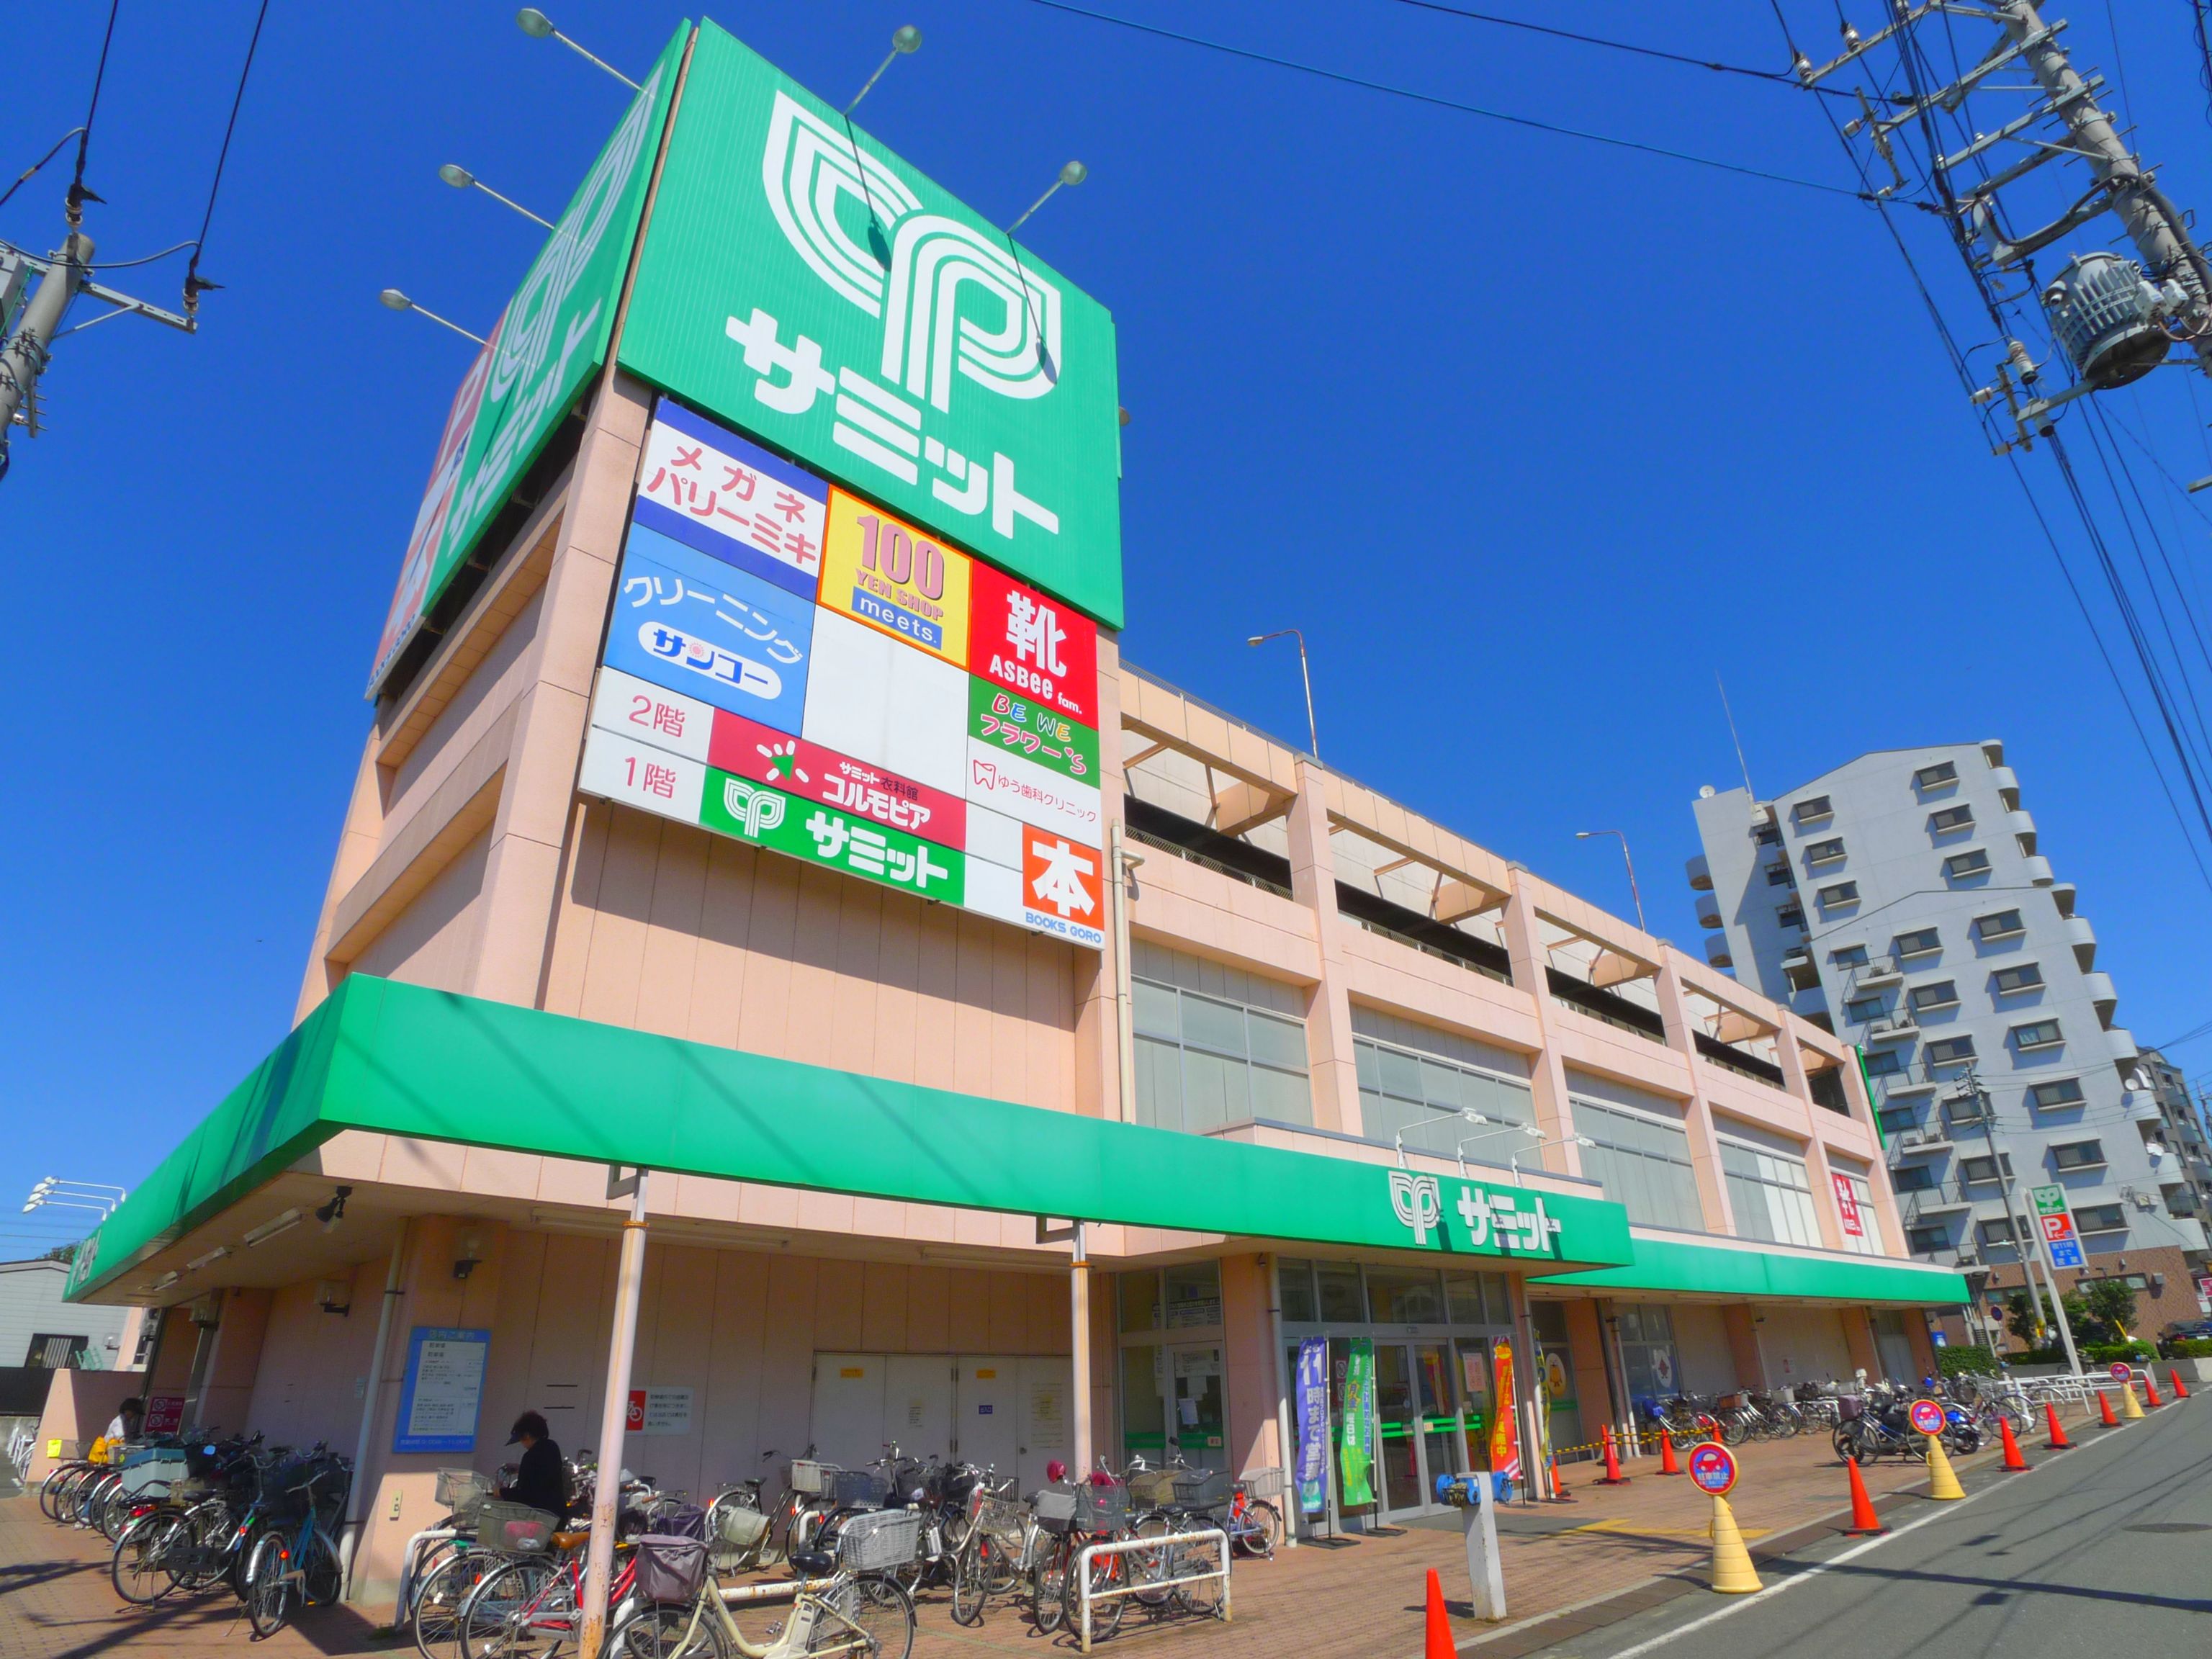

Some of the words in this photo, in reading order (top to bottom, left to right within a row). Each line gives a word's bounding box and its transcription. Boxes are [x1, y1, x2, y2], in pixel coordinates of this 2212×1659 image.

[726, 307, 1059, 540] サミット
[671, 446, 806, 523] メガネ
[647, 467, 817, 565] パリーミキ
[856, 513, 944, 601] 100
[624, 575, 804, 664] クリーニング
[855, 568, 891, 598] YEN
[894, 585, 944, 621] SHOP
[860, 596, 938, 644] meets.
[653, 629, 768, 685] サンコー
[1007, 590, 1067, 677] 靴
[989, 655, 1053, 701] ASBee
[1057, 692, 1082, 714] fam.
[629, 695, 685, 738] 2階
[992, 693, 1027, 722] BE
[1036, 712, 1072, 742] WE
[624, 756, 677, 799] 1階
[823, 773, 931, 830] コルモピア
[998, 775, 1097, 822] ゆう歯科クリニック
[806, 810, 948, 889] サミット
[1032, 839, 1095, 917] 本
[1026, 912, 1066, 934] BOOKS
[1069, 925, 1102, 944] GORO
[1457, 1186, 1561, 1253] サミット
[2044, 1218, 2062, 1238] P
